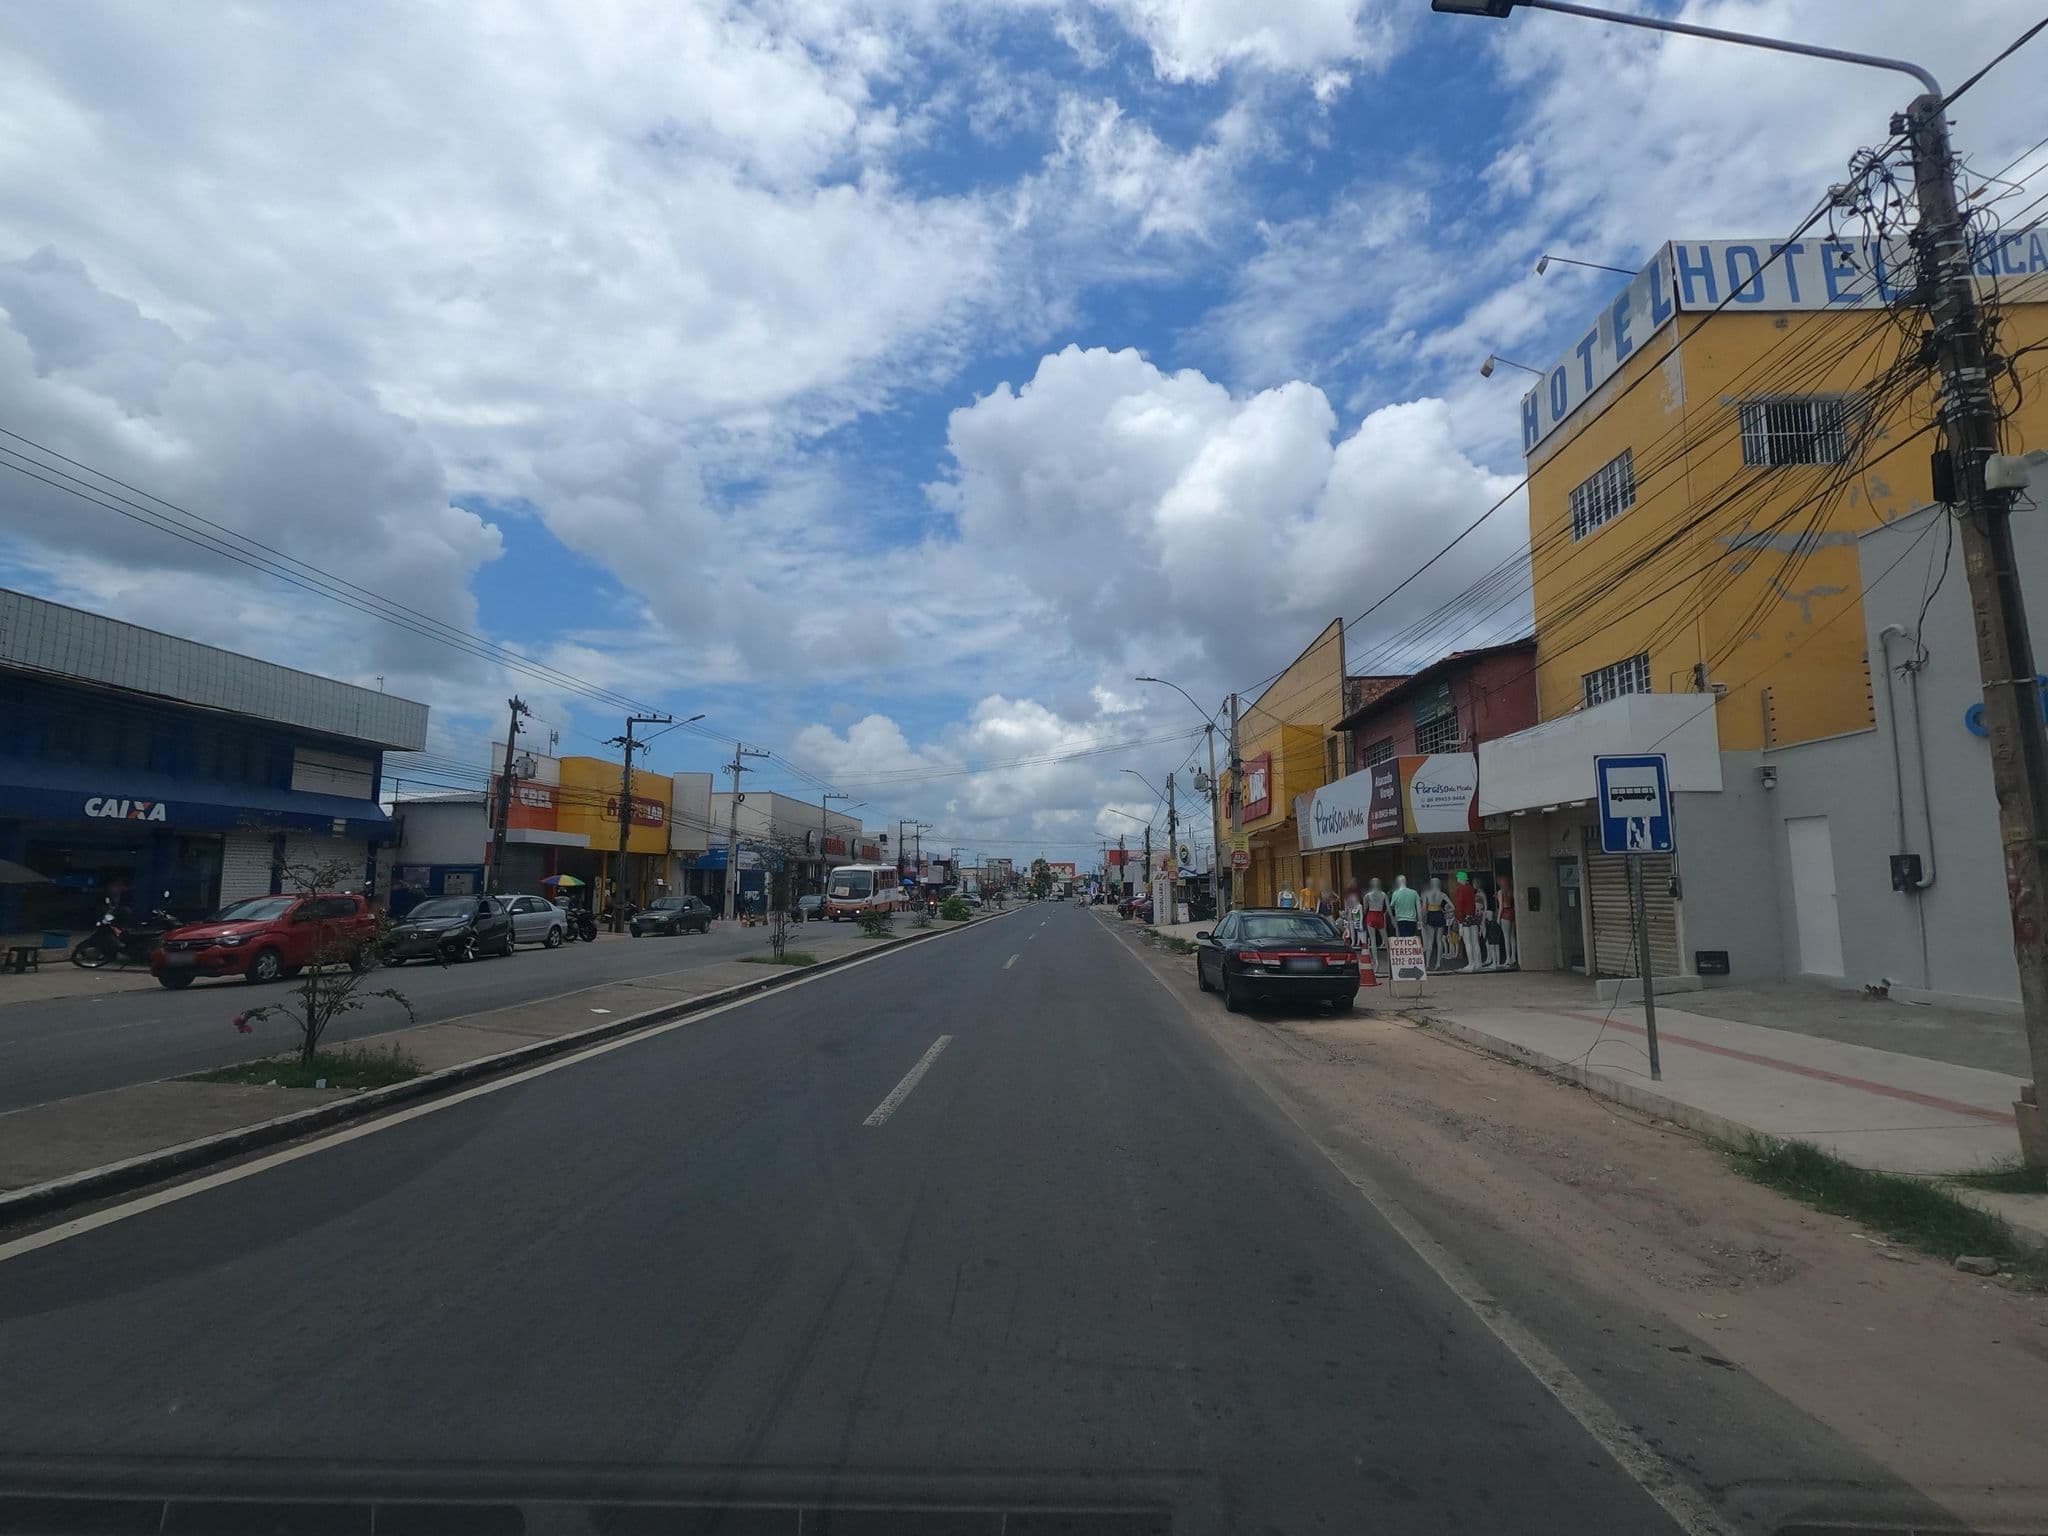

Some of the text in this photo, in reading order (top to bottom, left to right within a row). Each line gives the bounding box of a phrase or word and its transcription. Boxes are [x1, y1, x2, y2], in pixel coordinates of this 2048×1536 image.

[1677, 242, 1917, 303] HOTEL
[1523, 262, 1671, 451] HOTEL
[85, 797, 167, 822] CAIXA
